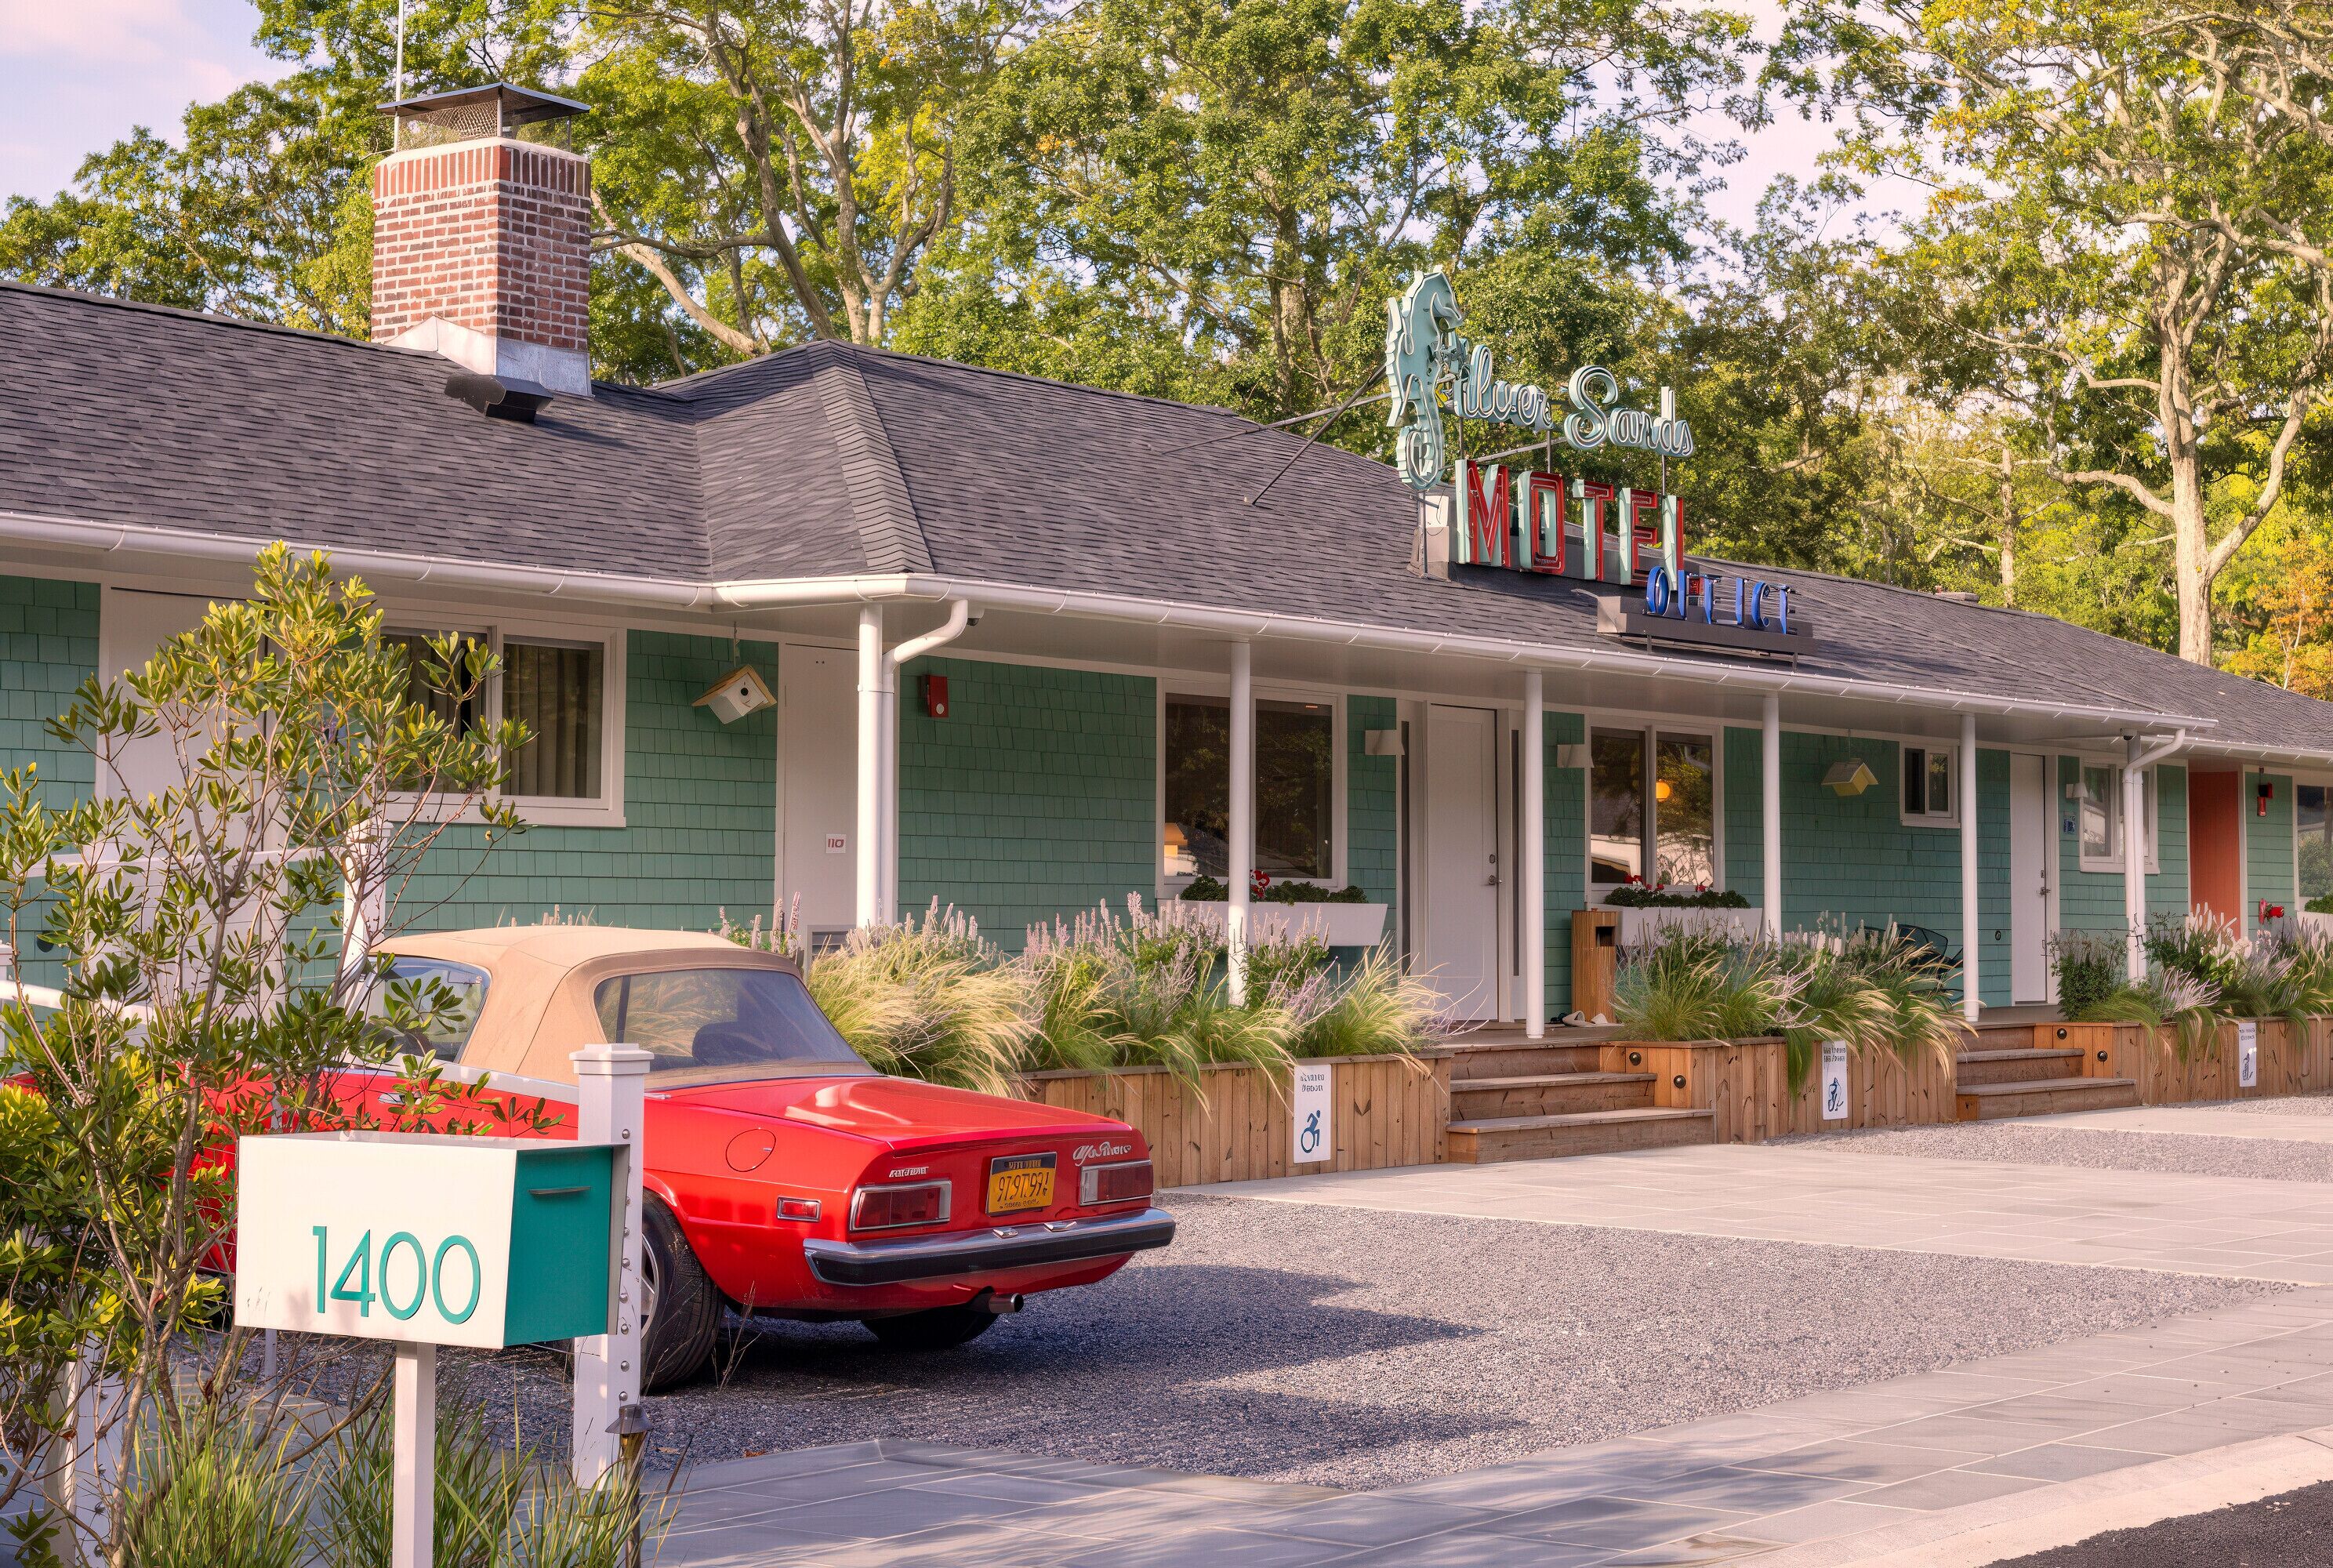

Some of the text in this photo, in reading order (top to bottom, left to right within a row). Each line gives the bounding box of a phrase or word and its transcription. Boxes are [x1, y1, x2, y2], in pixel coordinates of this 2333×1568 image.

[1564, 365, 1695, 457] Sands
[1454, 459, 1685, 592] MOTEL
[312, 1225, 481, 1325] 1400
